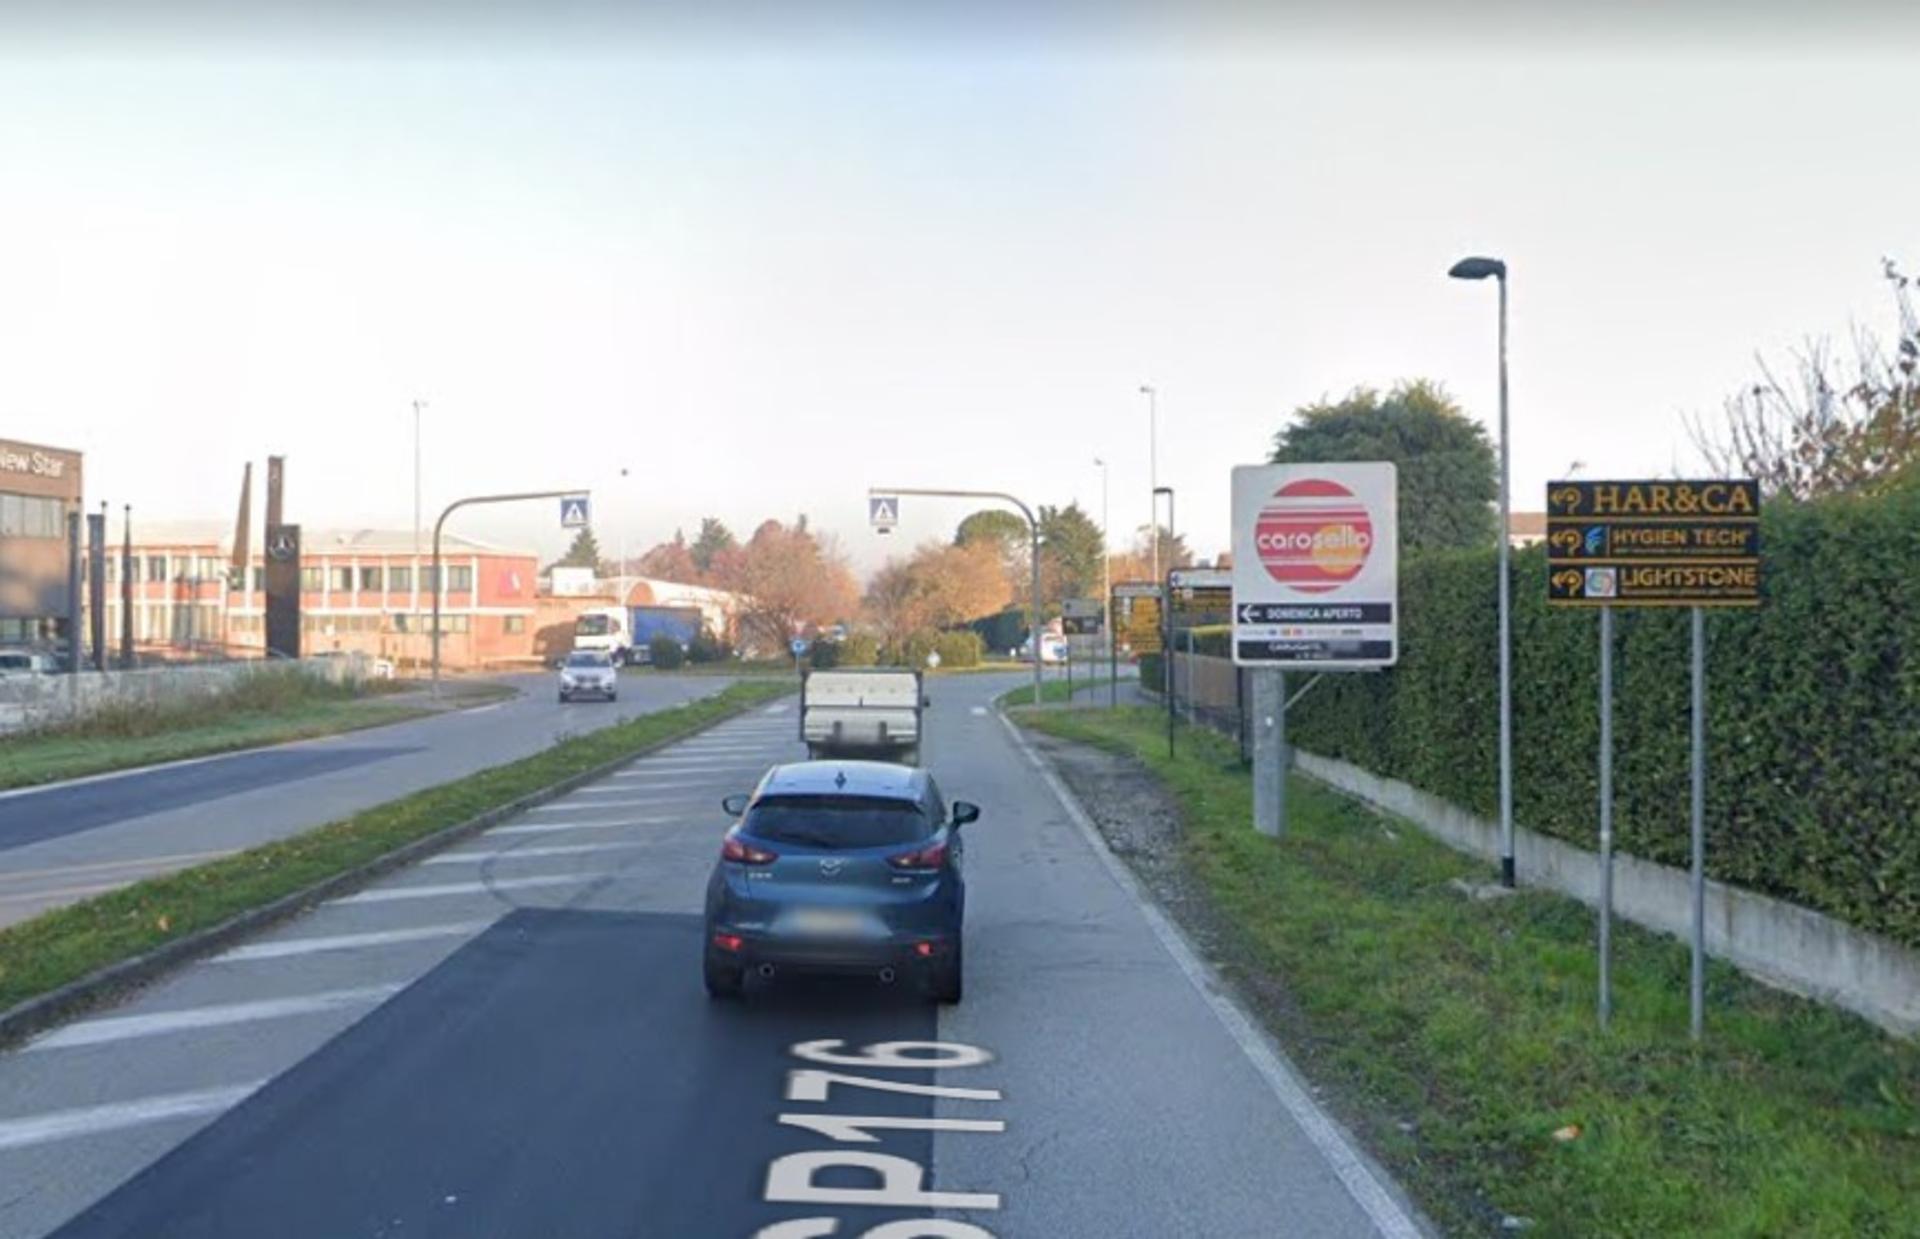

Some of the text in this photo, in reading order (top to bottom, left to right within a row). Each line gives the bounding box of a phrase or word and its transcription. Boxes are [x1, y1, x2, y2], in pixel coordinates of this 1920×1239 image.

[1592, 484, 1753, 513] HAR&CA
[1613, 529, 1687, 545] HYGIEN
[1621, 568, 1757, 586] LIGHTSTONE
